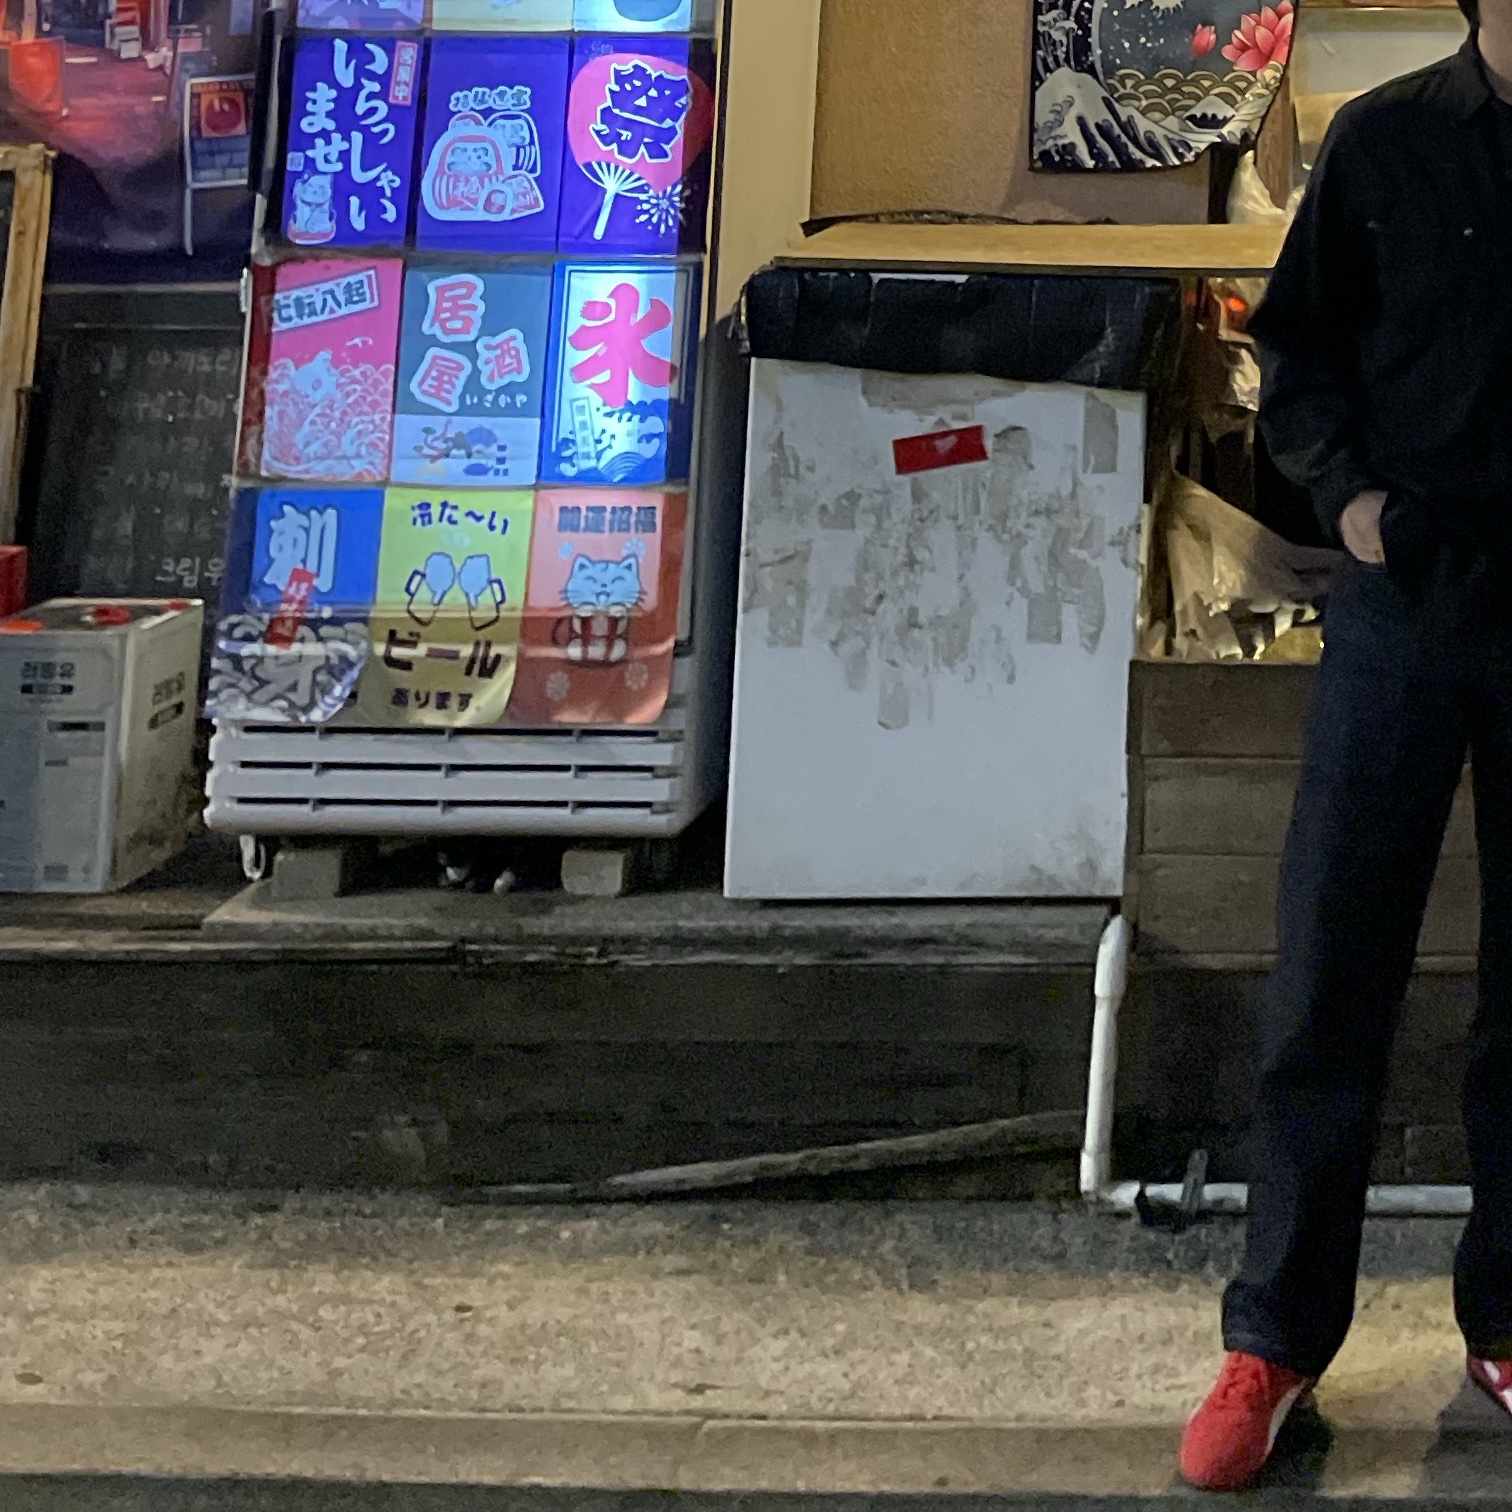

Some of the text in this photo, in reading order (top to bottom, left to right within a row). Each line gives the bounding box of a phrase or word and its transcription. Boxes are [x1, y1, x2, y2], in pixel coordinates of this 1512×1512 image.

[272, 277, 370, 328] 七転八起
[416, 279, 527, 411] 居酒屋
[568, 282, 678, 408] 氷
[383, 628, 502, 680] ビール
[391, 687, 473, 713] あります
